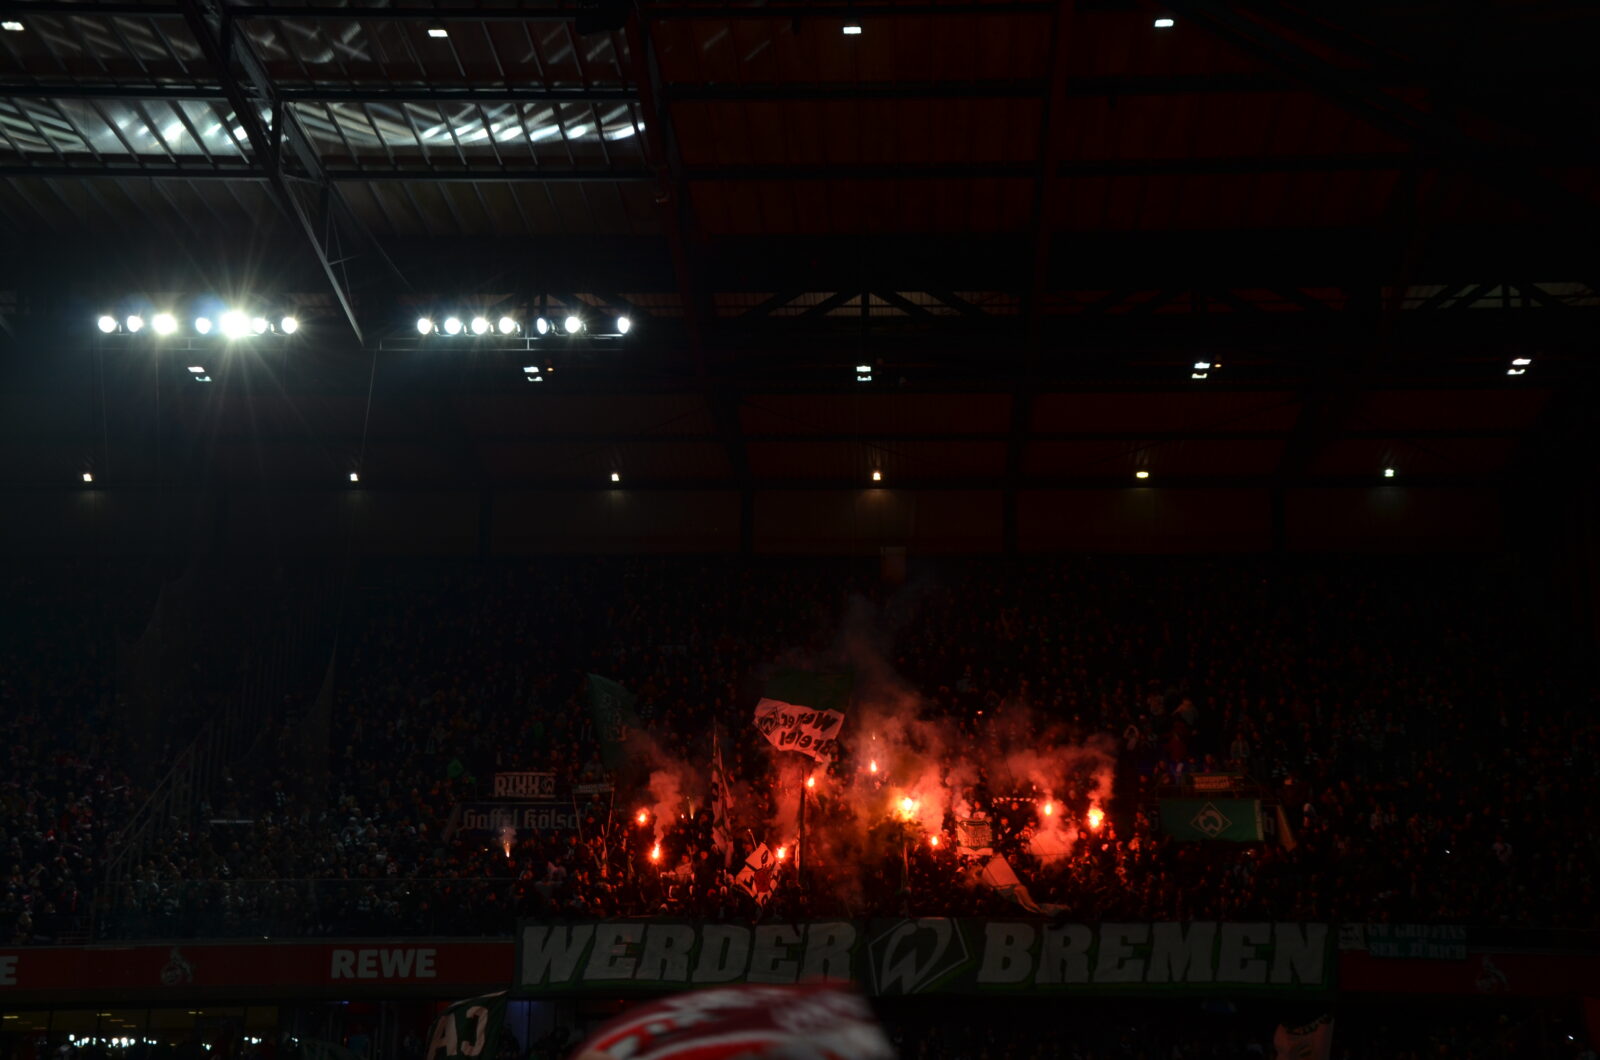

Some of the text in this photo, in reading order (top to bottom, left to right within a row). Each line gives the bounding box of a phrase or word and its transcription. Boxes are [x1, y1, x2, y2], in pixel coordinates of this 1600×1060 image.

[330, 948, 438, 979] REWE
[520, 921, 858, 986] WERDER
[977, 921, 1328, 985] BREMEN
